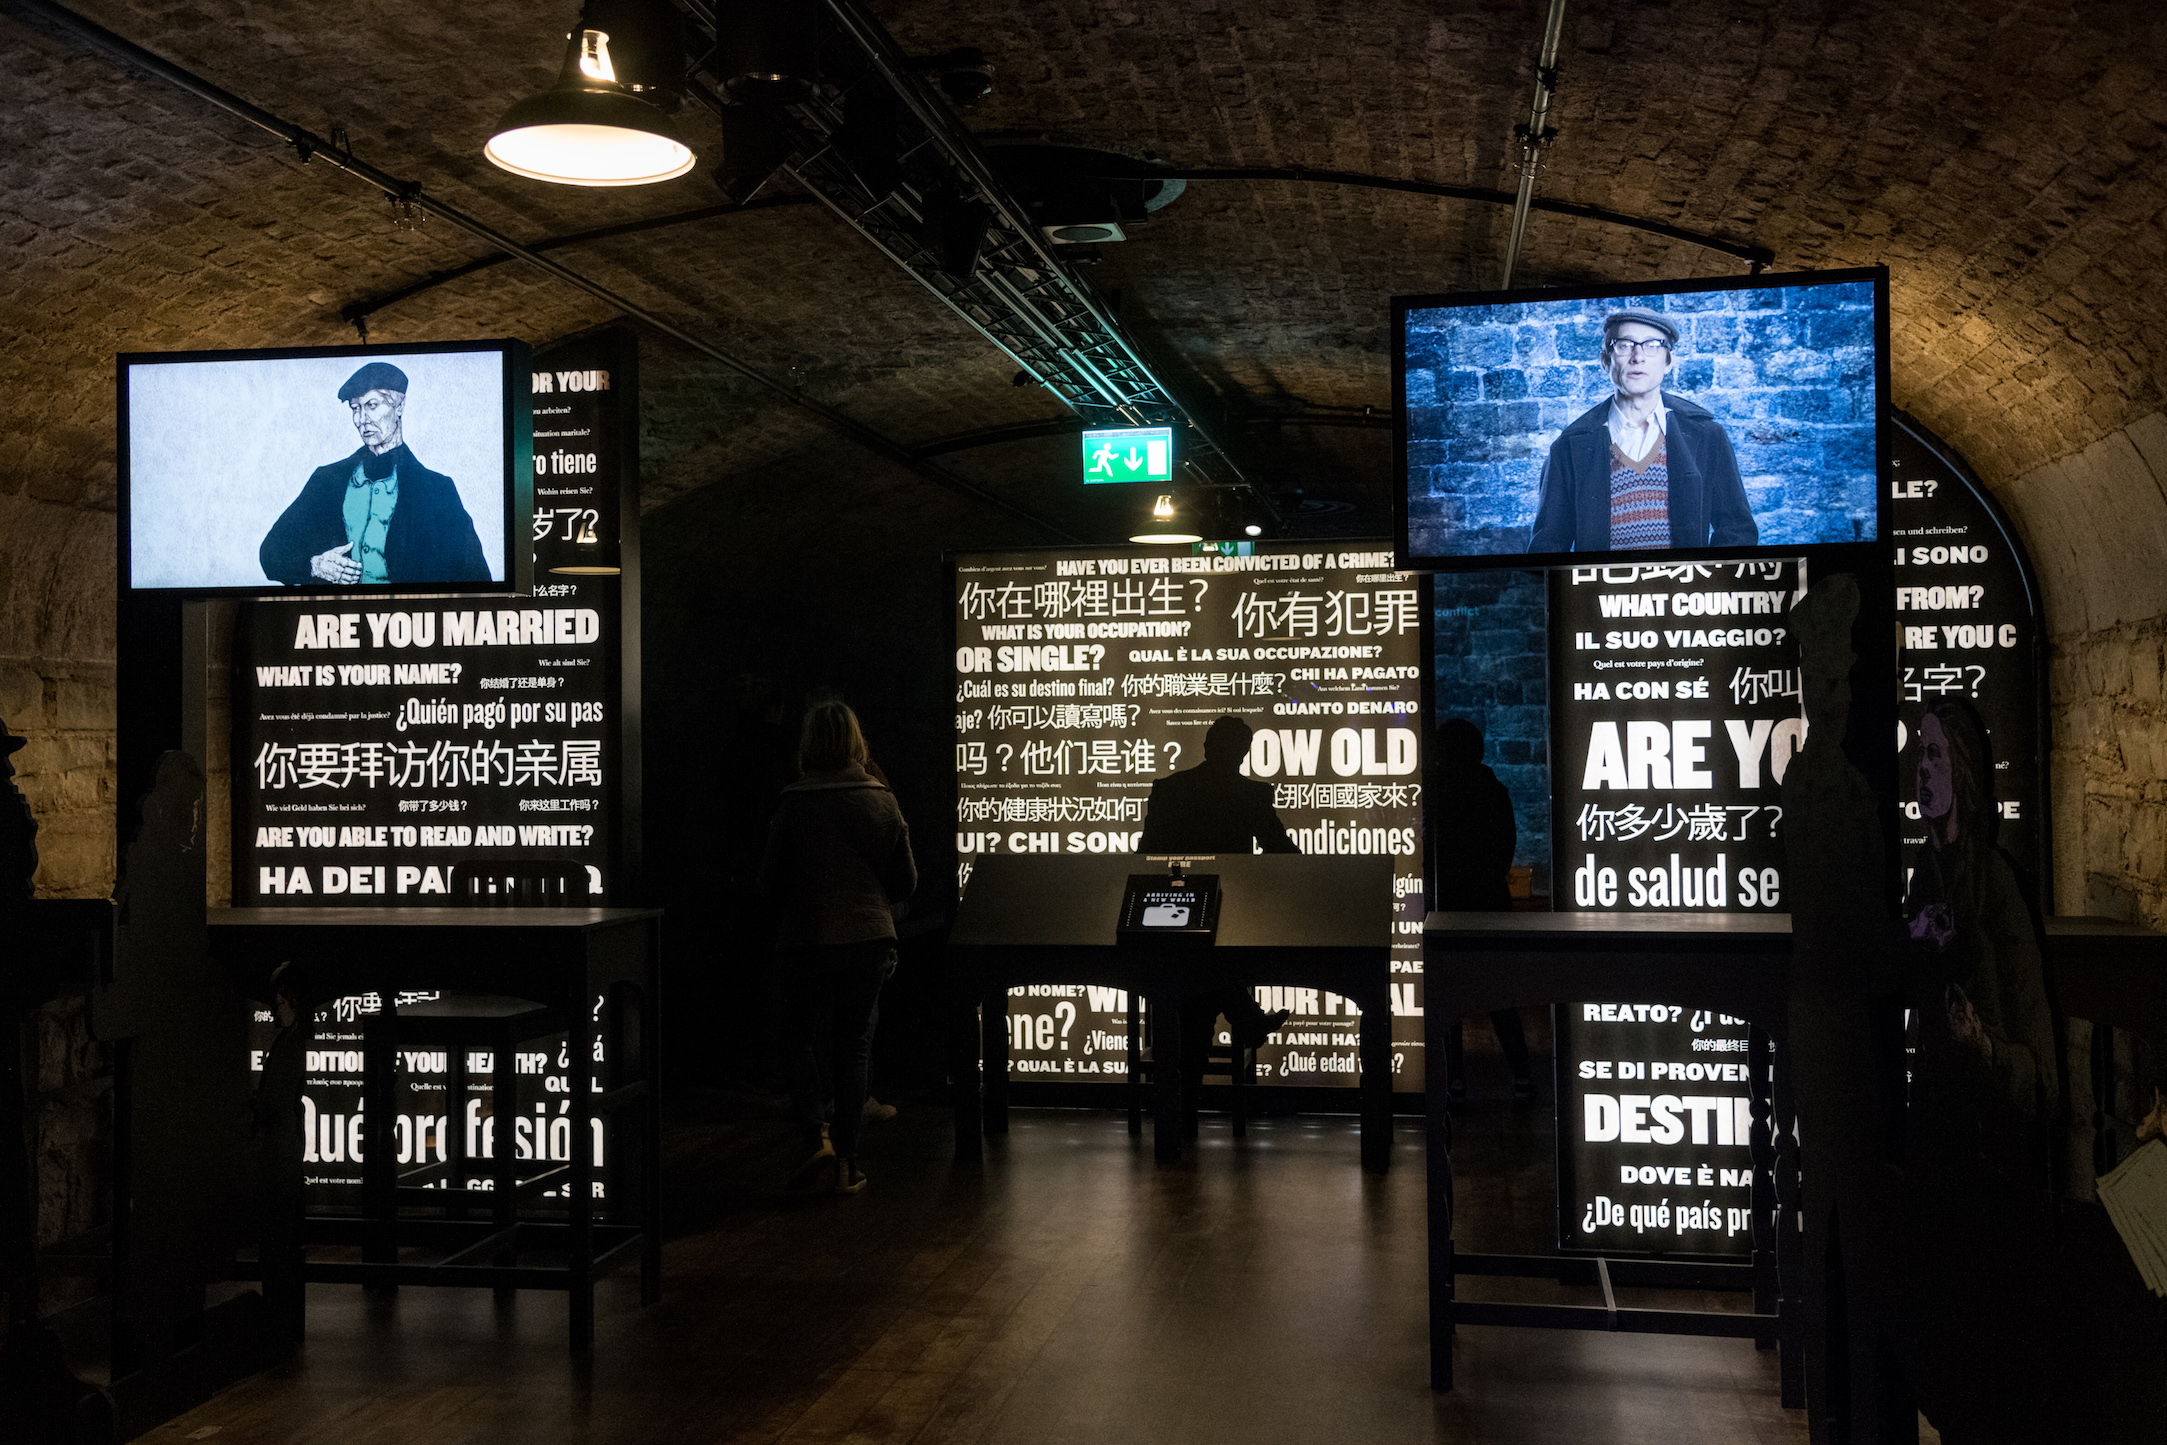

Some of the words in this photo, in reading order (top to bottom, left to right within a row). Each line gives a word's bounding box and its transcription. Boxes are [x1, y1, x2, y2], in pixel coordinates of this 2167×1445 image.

[555, 370, 611, 392] YOUR
[541, 406, 571, 414] arbeiten?
[560, 428, 590, 436] maritale?
[551, 449, 597, 475] tiene
[537, 487, 558, 495] Wohin
[1907, 527, 1924, 535] und
[1925, 525, 1967, 534] schreiben?
[1056, 560, 1095, 575] HAVE
[1097, 559, 1128, 574] YOU
[1131, 558, 1169, 573] EVER
[1171, 556, 1211, 573] BEEN
[1211, 554, 1300, 572] CONVICTED
[1302, 554, 1322, 569] OF
[1325, 553, 1336, 568] A
[1338, 551, 1394, 568] CRIME?
[1912, 545, 1988, 565] SONO
[958, 577, 1208, 620] 你在哪裡出生？
[1598, 593, 1668, 617] WHAT
[1671, 591, 1785, 616] COUNTRY
[1897, 585, 1985, 610] FROM?
[1231, 590, 1420, 639] 你有犯罪
[294, 613, 360, 649] ARE
[365, 611, 435, 647] YOU
[442, 608, 599, 646] MARRIED
[981, 624, 1025, 640] WHAT
[1027, 624, 1042, 639] IS
[1044, 623, 1085, 639] YOUR
[1087, 620, 1191, 638] OCCUPATION?
[1575, 632, 1600, 649] IL
[1604, 630, 1658, 649] SUO
[1663, 628, 1785, 647] VIAGGIO?
[1941, 624, 1993, 648] YOU
[562, 658, 575, 666] sind
[956, 646, 992, 673] OR
[996, 643, 1105, 672] SINGLE?
[1128, 649, 1174, 662] QUAL
[1176, 646, 1187, 661] È
[1191, 648, 1213, 661] LA
[1216, 648, 1250, 660] SUA
[1253, 645, 1382, 659] OCCUPAZIONE?
[1593, 659, 1612, 670] Quel
[1647, 661, 1664, 669] pays
[1665, 658, 1704, 668] d'origine?
[256, 665, 312, 686] WHAT
[315, 664, 334, 686] IS
[337, 664, 390, 685] YOUR
[393, 662, 462, 684] NAME?
[480, 677, 565, 689] 你结婚了还是单身？
[1121, 672, 1287, 697] 你的職業是什麼？
[1290, 668, 1320, 681] CHI
[1323, 667, 1348, 680] HA
[1351, 666, 1419, 679] PAGATO
[956, 679, 990, 702] ¿Cuál
[994, 684, 1008, 697] es
[1011, 683, 1026, 697] su
[1029, 678, 1075, 697] destino
[1077, 677, 1114, 696] final?
[1574, 682, 1610, 700] HA
[1615, 681, 1669, 699] CON
[1674, 676, 1708, 699] SÉ
[1728, 666, 1801, 705] 你叫
[348, 713, 360, 721] par
[366, 711, 390, 720] justice?
[395, 697, 458, 731] ¿Quién
[463, 696, 505, 729] pagó
[510, 702, 540, 728] por
[544, 702, 566, 722] su
[571, 701, 602, 728] pas
[987, 703, 1141, 730] 你可以讀寫嗎？
[1273, 702, 1343, 715] QUANTO
[1347, 701, 1418, 714] DENARO
[956, 739, 1183, 775] 吗？他们是谁？
[1239, 728, 1322, 777] OW
[1330, 727, 1417, 776] OLD
[1582, 719, 1712, 789] ARE
[254, 740, 602, 790] 你要拜访你的亲属
[339, 803, 349, 811] bei
[398, 800, 467, 813] 你带了多少钱？
[519, 799, 600, 812] 你来这里工作吗？
[957, 796, 1149, 822] 你的健康狀況如何
[1576, 803, 1783, 841] 你多少歲了？
[255, 826, 293, 847] ARE
[295, 826, 336, 847] YOU
[338, 826, 387, 847] ABLE
[390, 825, 416, 847] TO
[420, 825, 471, 846] READ
[474, 825, 516, 846] AND
[518, 824, 593, 846] WRITE?
[957, 832, 1001, 852] UI?
[1008, 831, 1059, 853] CHI
[259, 866, 312, 894] HA
[322, 866, 385, 894] DEI
[1575, 853, 1617, 906] de
[1628, 853, 1726, 907] salud
[1738, 867, 1778, 906] se
[1028, 985, 1086, 997] NOME?
[1583, 1003, 1682, 1022] REATO?
[336, 1032, 357, 1041] jemals
[1286, 1033, 1328, 1045] ANNI
[1017, 1059, 1060, 1072] QUAL
[1064, 1059, 1074, 1072] È
[1078, 1061, 1100, 1073] LA
[1279, 1051, 1316, 1076] ¿Qué
[1320, 1052, 1354, 1072] edad
[1578, 1060, 1612, 1079] SE
[1618, 1061, 1644, 1079] DI
[1651, 1062, 1749, 1081] PROVEN
[1584, 1094, 1750, 1146] DESTI
[1620, 1165, 1691, 1185] DOVE
[1697, 1164, 1713, 1186] È
[1582, 1196, 1624, 1233] ¿De
[1630, 1198, 1670, 1233] qué
[1675, 1199, 1722, 1235] país
